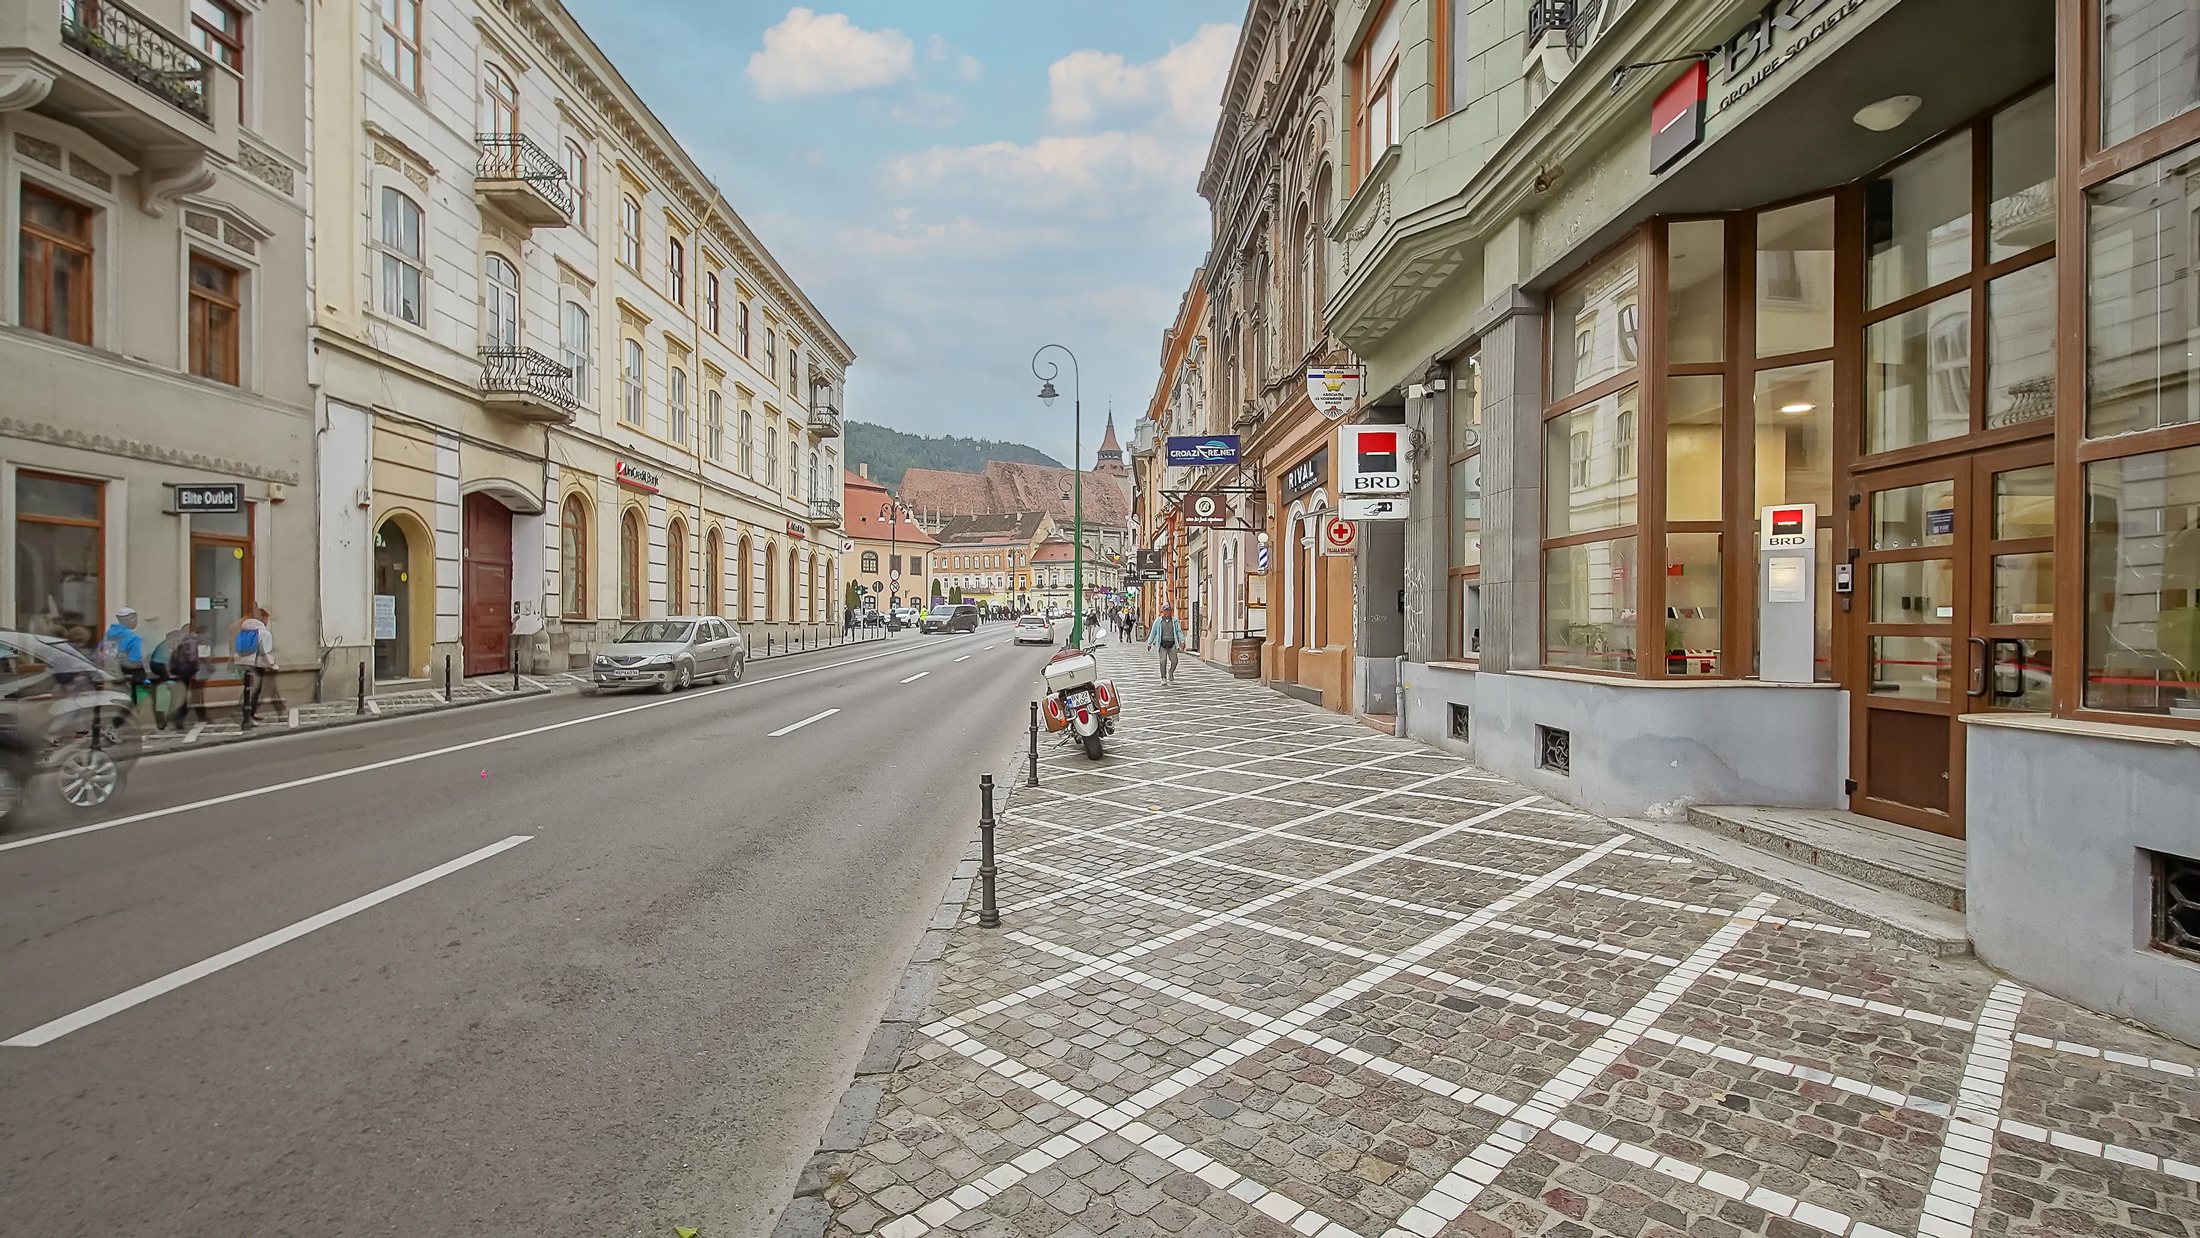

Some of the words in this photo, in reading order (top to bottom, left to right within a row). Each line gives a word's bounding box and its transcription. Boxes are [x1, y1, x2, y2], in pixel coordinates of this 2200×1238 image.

[1722, 0, 1829, 86] BR
[1720, 57, 1780, 112] GROUPE
[1288, 460, 1314, 490] RIVAL
[1354, 476, 1400, 489] BRD
[204, 490, 234, 505] Outlet
[1769, 537, 1806, 546] BRD
